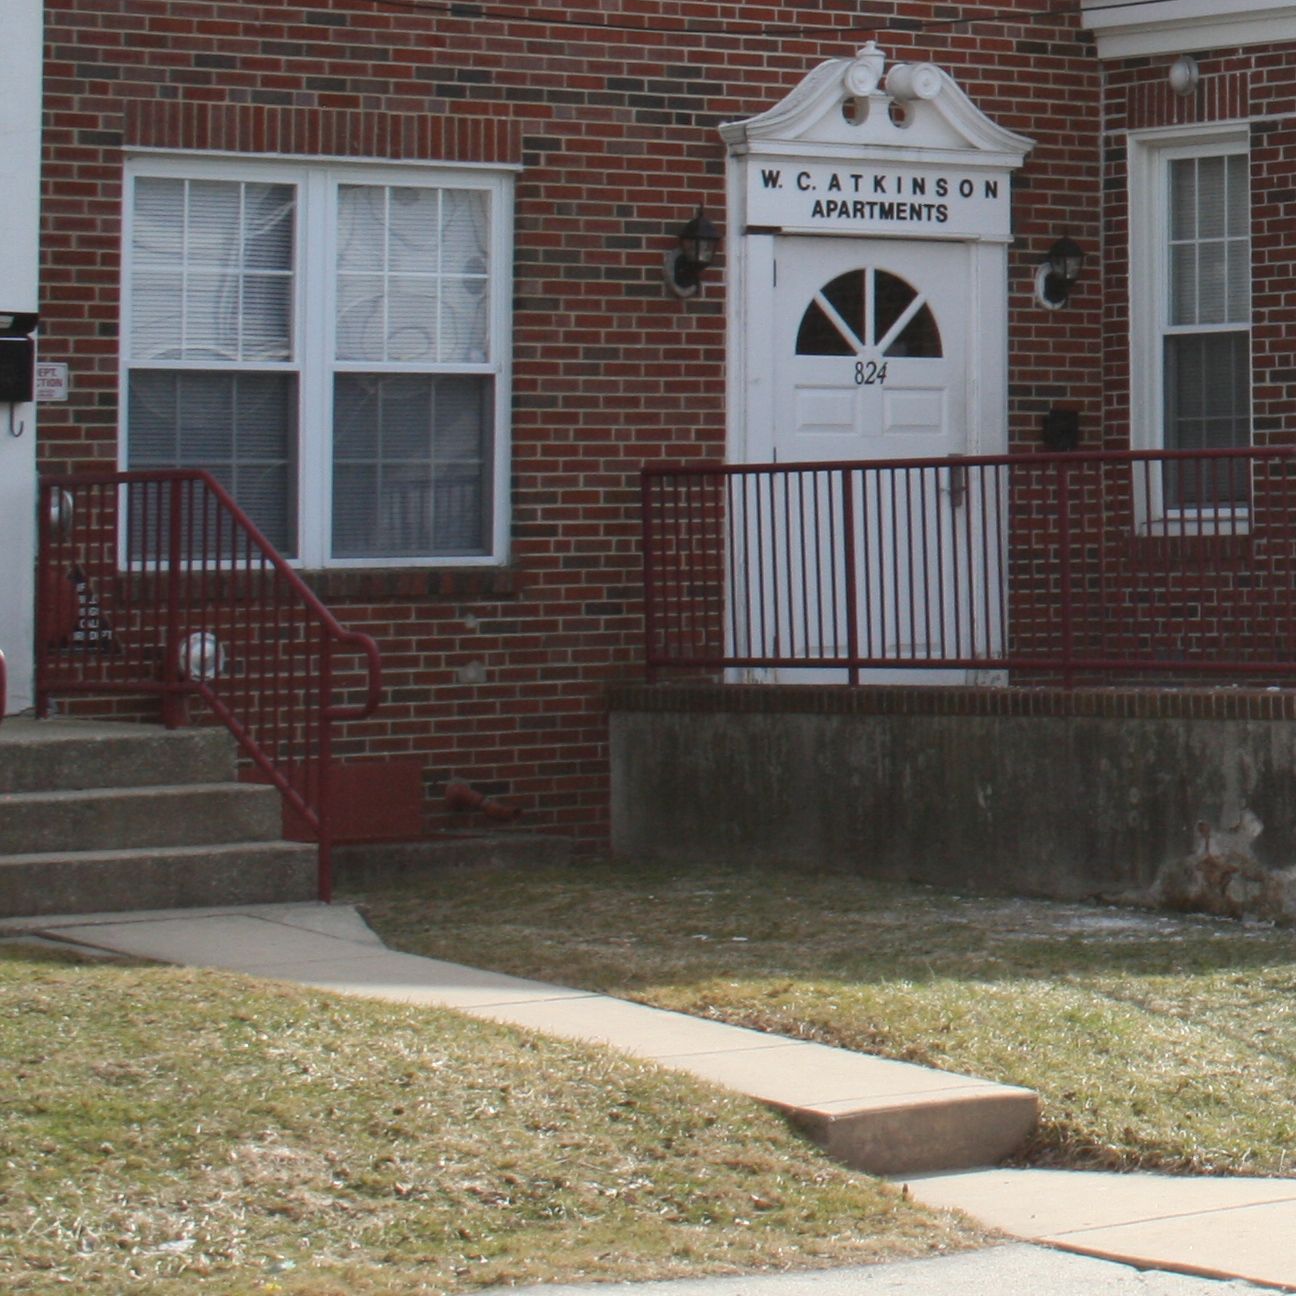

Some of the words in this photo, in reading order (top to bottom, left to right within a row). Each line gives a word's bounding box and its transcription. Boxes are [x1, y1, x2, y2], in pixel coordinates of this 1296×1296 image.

[761, 170, 782, 189] W.
[796, 171, 816, 191] C.
[828, 173, 998, 199] ATKINSON
[811, 199, 948, 223] APARTMENTS
[36, 367, 57, 377] EPT.
[854, 361, 887, 385] 824
